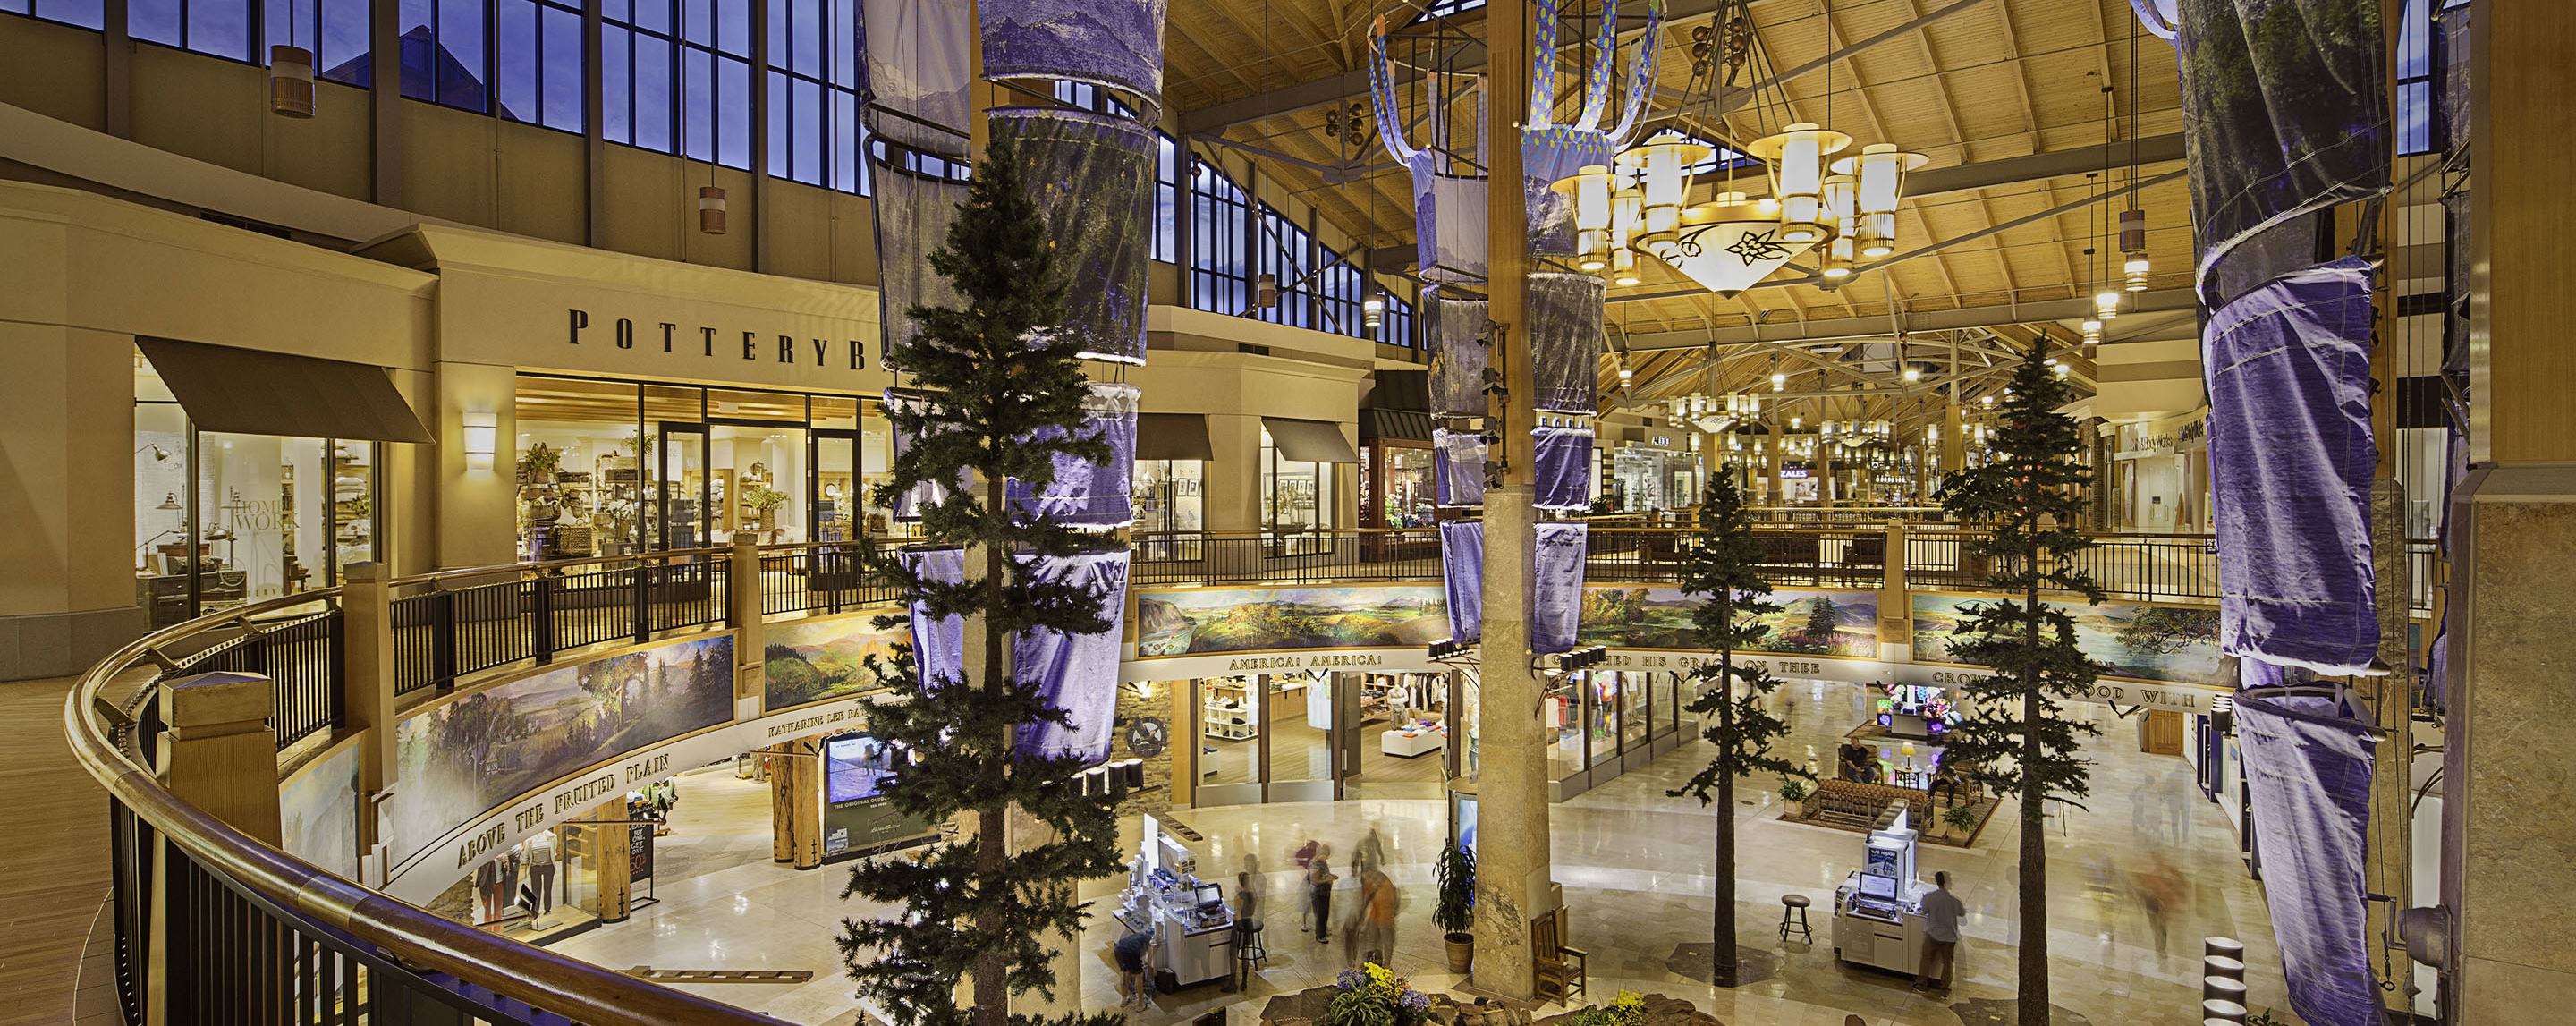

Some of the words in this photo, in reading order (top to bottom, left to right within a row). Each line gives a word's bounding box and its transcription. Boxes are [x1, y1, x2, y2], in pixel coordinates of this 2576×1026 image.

[1780, 470, 1807, 478] ZALES
[1229, 657, 1301, 671] AMERICA!
[1310, 654, 1382, 667] AMERICA!
[1603, 655, 1632, 666] HED
[1642, 656, 1667, 667] HIS
[1678, 657, 1724, 668] GRAC
[1779, 661, 1821, 674] THEE
[1932, 672, 1990, 685] CROW
[2140, 688, 2197, 708] WITH
[767, 715, 824, 738] KATHARINE
[826, 710, 844, 725] LEE
[457, 821, 506, 869] ABOVE
[514, 802, 545, 834] THE
[555, 773, 616, 815] FRUITED
[626, 752, 670, 784] PLAIN
